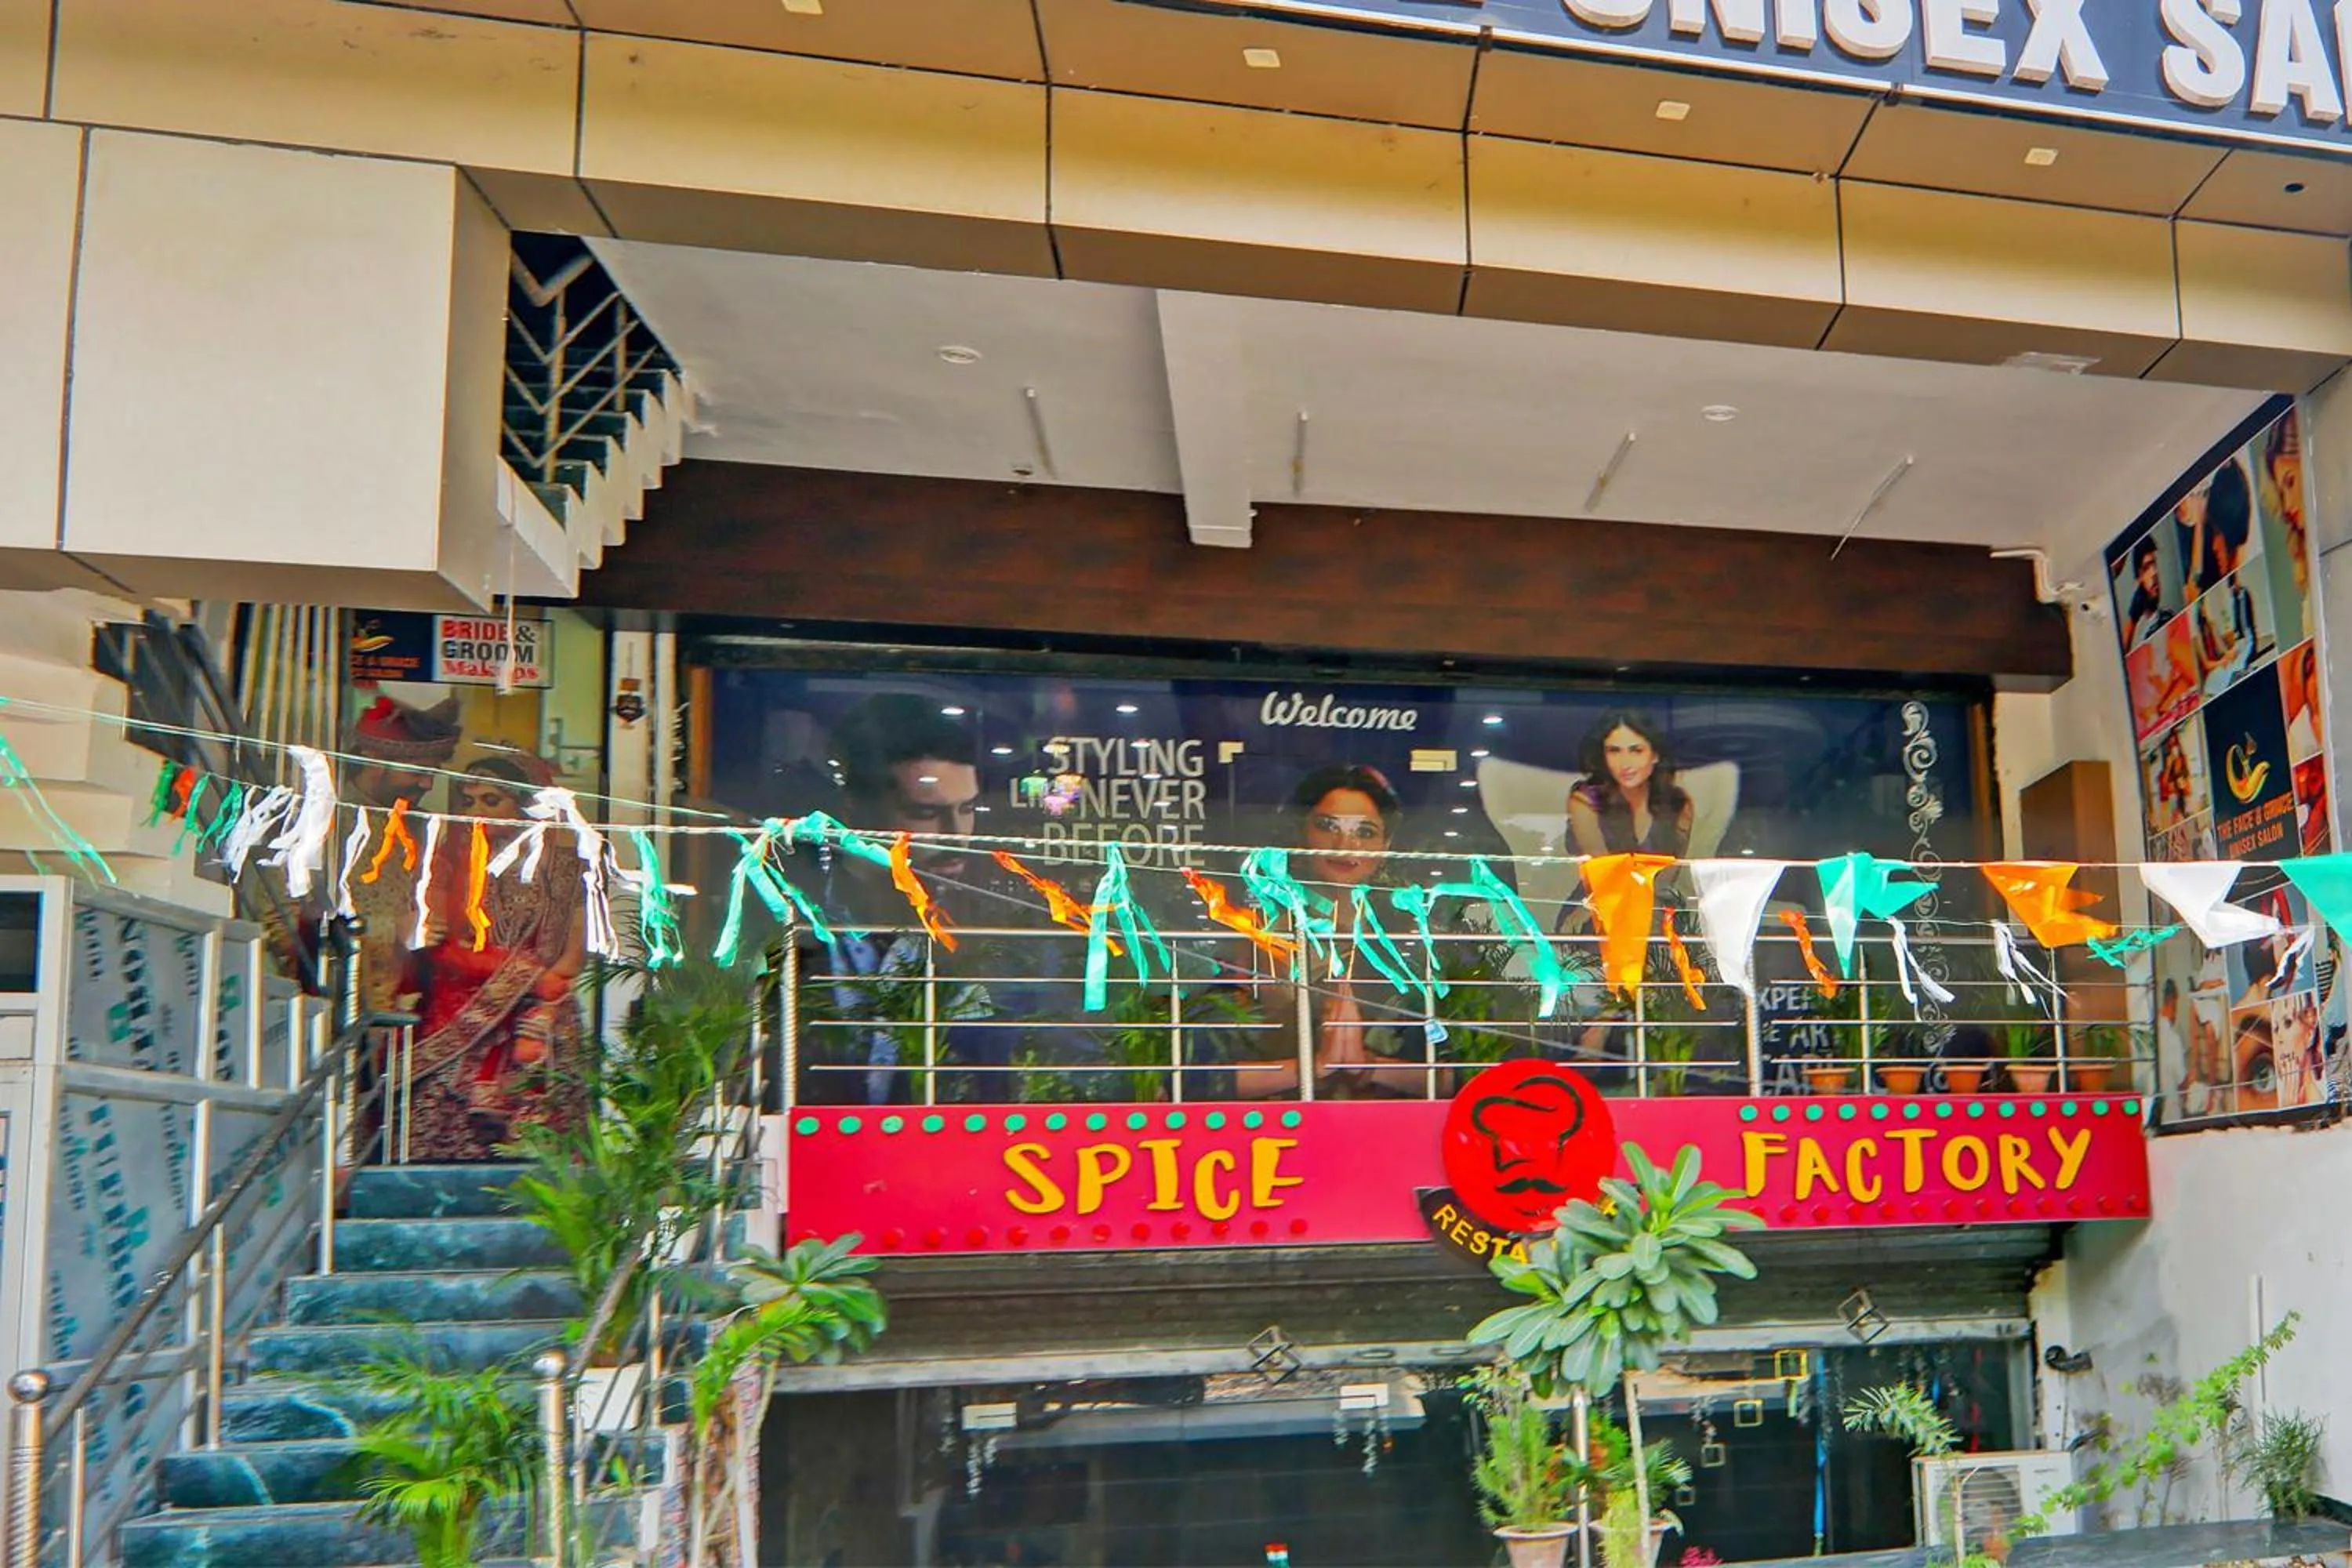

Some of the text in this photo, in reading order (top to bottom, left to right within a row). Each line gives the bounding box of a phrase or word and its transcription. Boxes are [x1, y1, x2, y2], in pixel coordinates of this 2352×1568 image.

[2161, 0, 2352, 127] SA
[441, 619, 535, 643] BRIDE &
[441, 641, 535, 662] GROOM
[1260, 691, 1418, 731] Welcome
[1047, 736, 1204, 777] STYLING
[1079, 776, 1206, 819] NEVER
[1043, 822, 1206, 867] BEFORE
[1003, 1126, 2092, 1221] SPICE FACTORY
